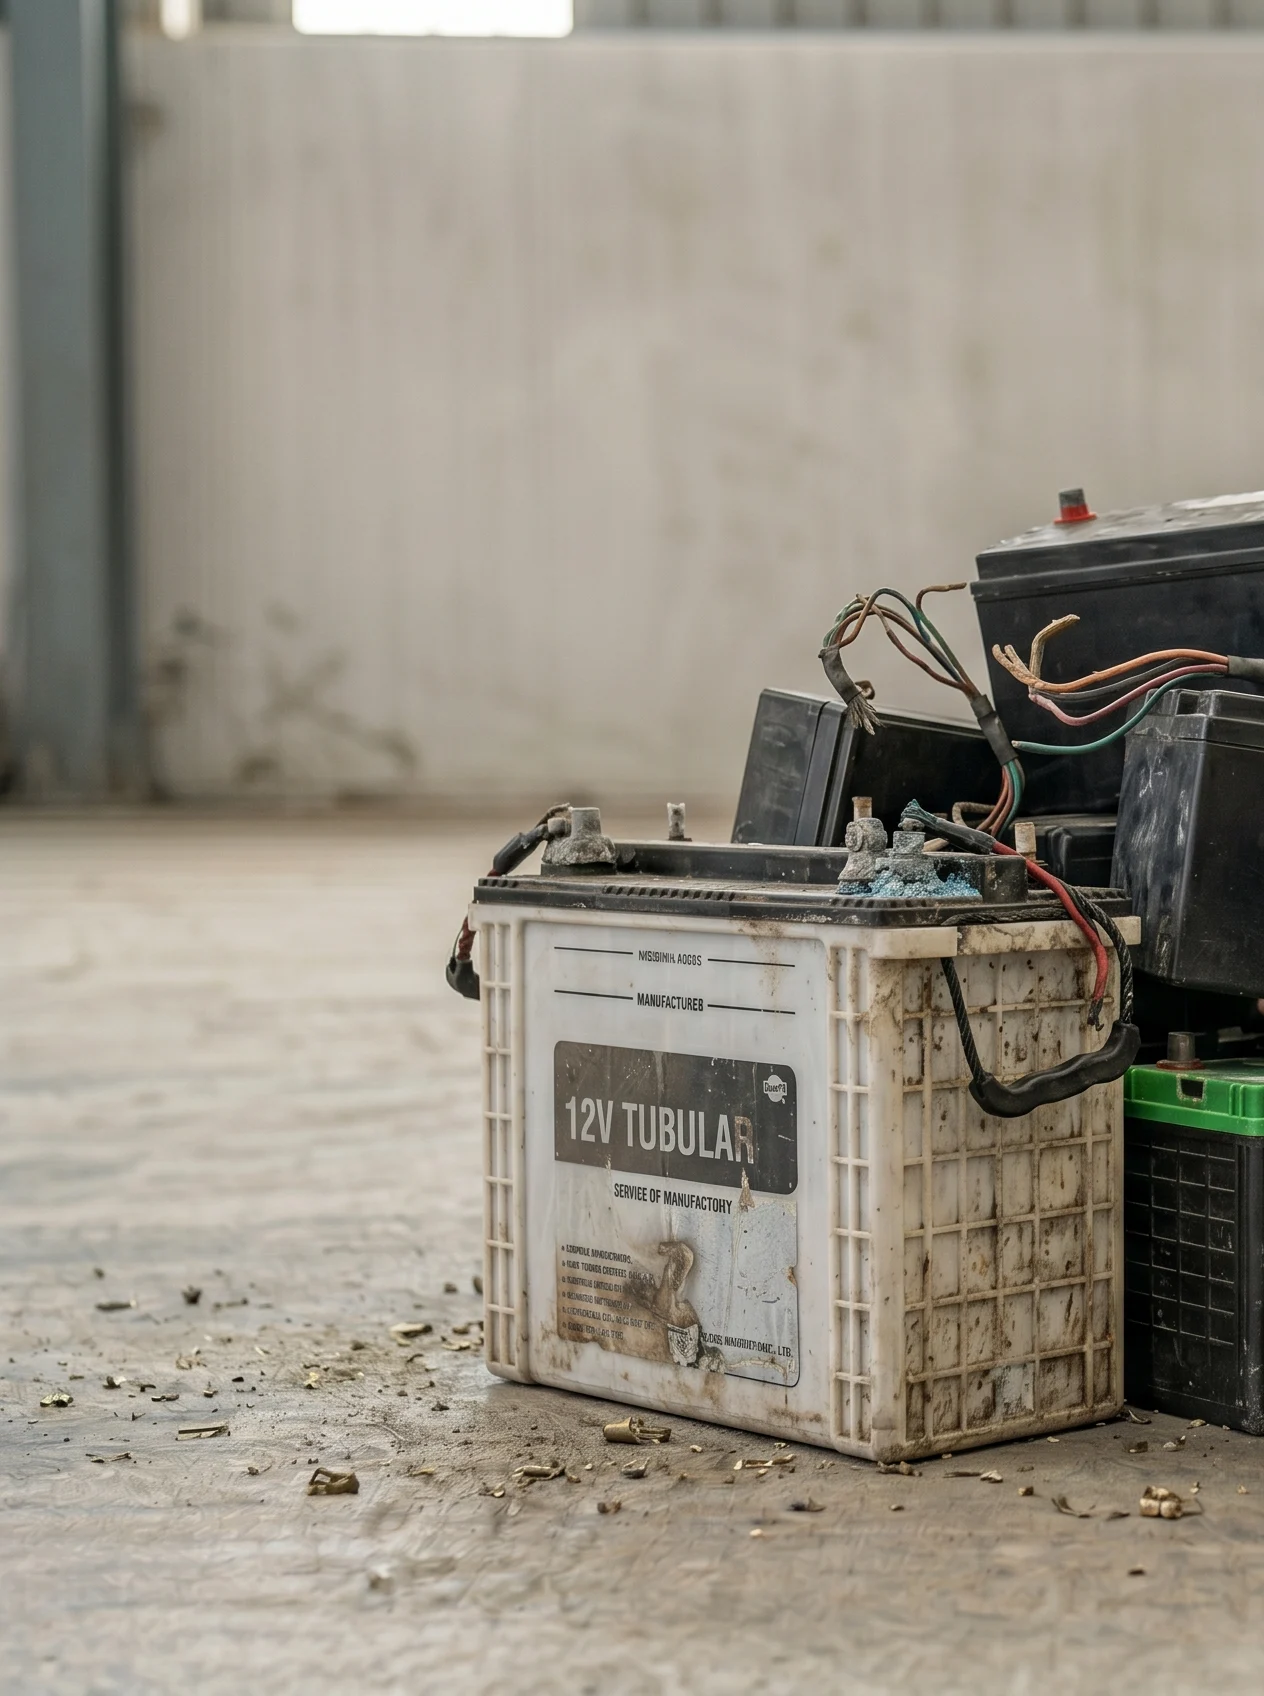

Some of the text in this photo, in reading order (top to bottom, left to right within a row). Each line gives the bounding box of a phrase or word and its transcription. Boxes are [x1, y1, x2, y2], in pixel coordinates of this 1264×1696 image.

[565, 1096, 754, 1164] 12V TUBULAR
[649, 1188, 661, 1203] OF
